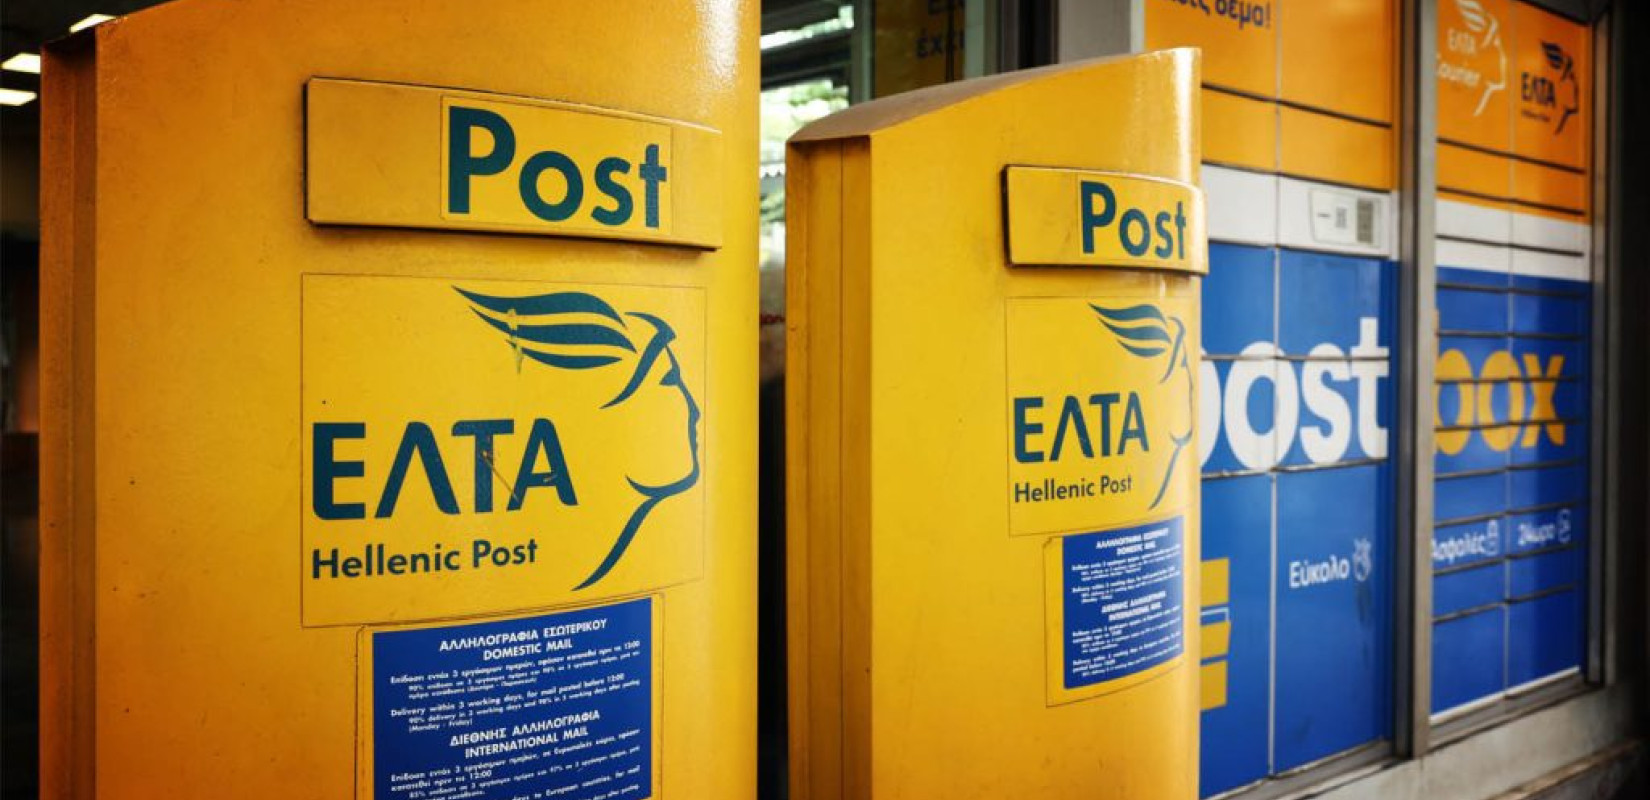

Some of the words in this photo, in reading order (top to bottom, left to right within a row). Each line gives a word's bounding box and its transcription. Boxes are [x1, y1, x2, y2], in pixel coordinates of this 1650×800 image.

[449, 106, 667, 228] Post
[1080, 180, 1186, 260] Post
[1013, 391, 1150, 464] ΕΛΤΑ
[312, 418, 579, 520] ΕΛΤΑ
[1014, 478, 1095, 503] Hellenic
[1100, 474, 1132, 496] Post
[312, 543, 460, 579] Hellenic
[472, 539, 538, 568] Post
[1289, 554, 1350, 588] Εύκολο
[439, 630, 539, 652] ΑΛΛΗΛΟΓΡΑΦΙΑ
[543, 618, 608, 638] ΕΣΩΤΕΡΙΚΟΥ
[483, 643, 542, 661] DOMESTIC
[545, 639, 573, 652] MAIL
[390, 707, 426, 718] Delivery
[429, 702, 456, 713] within
[468, 697, 501, 708] working
[450, 728, 507, 747] ΔΙΕΘΝΗΣ
[512, 710, 600, 737] ΑΛΛΗΛΟΓΡΑΦΙΑ
[465, 733, 559, 759] INTERNATIONAL
[563, 726, 589, 741] MAIL
[469, 769, 492, 780] 12:00
